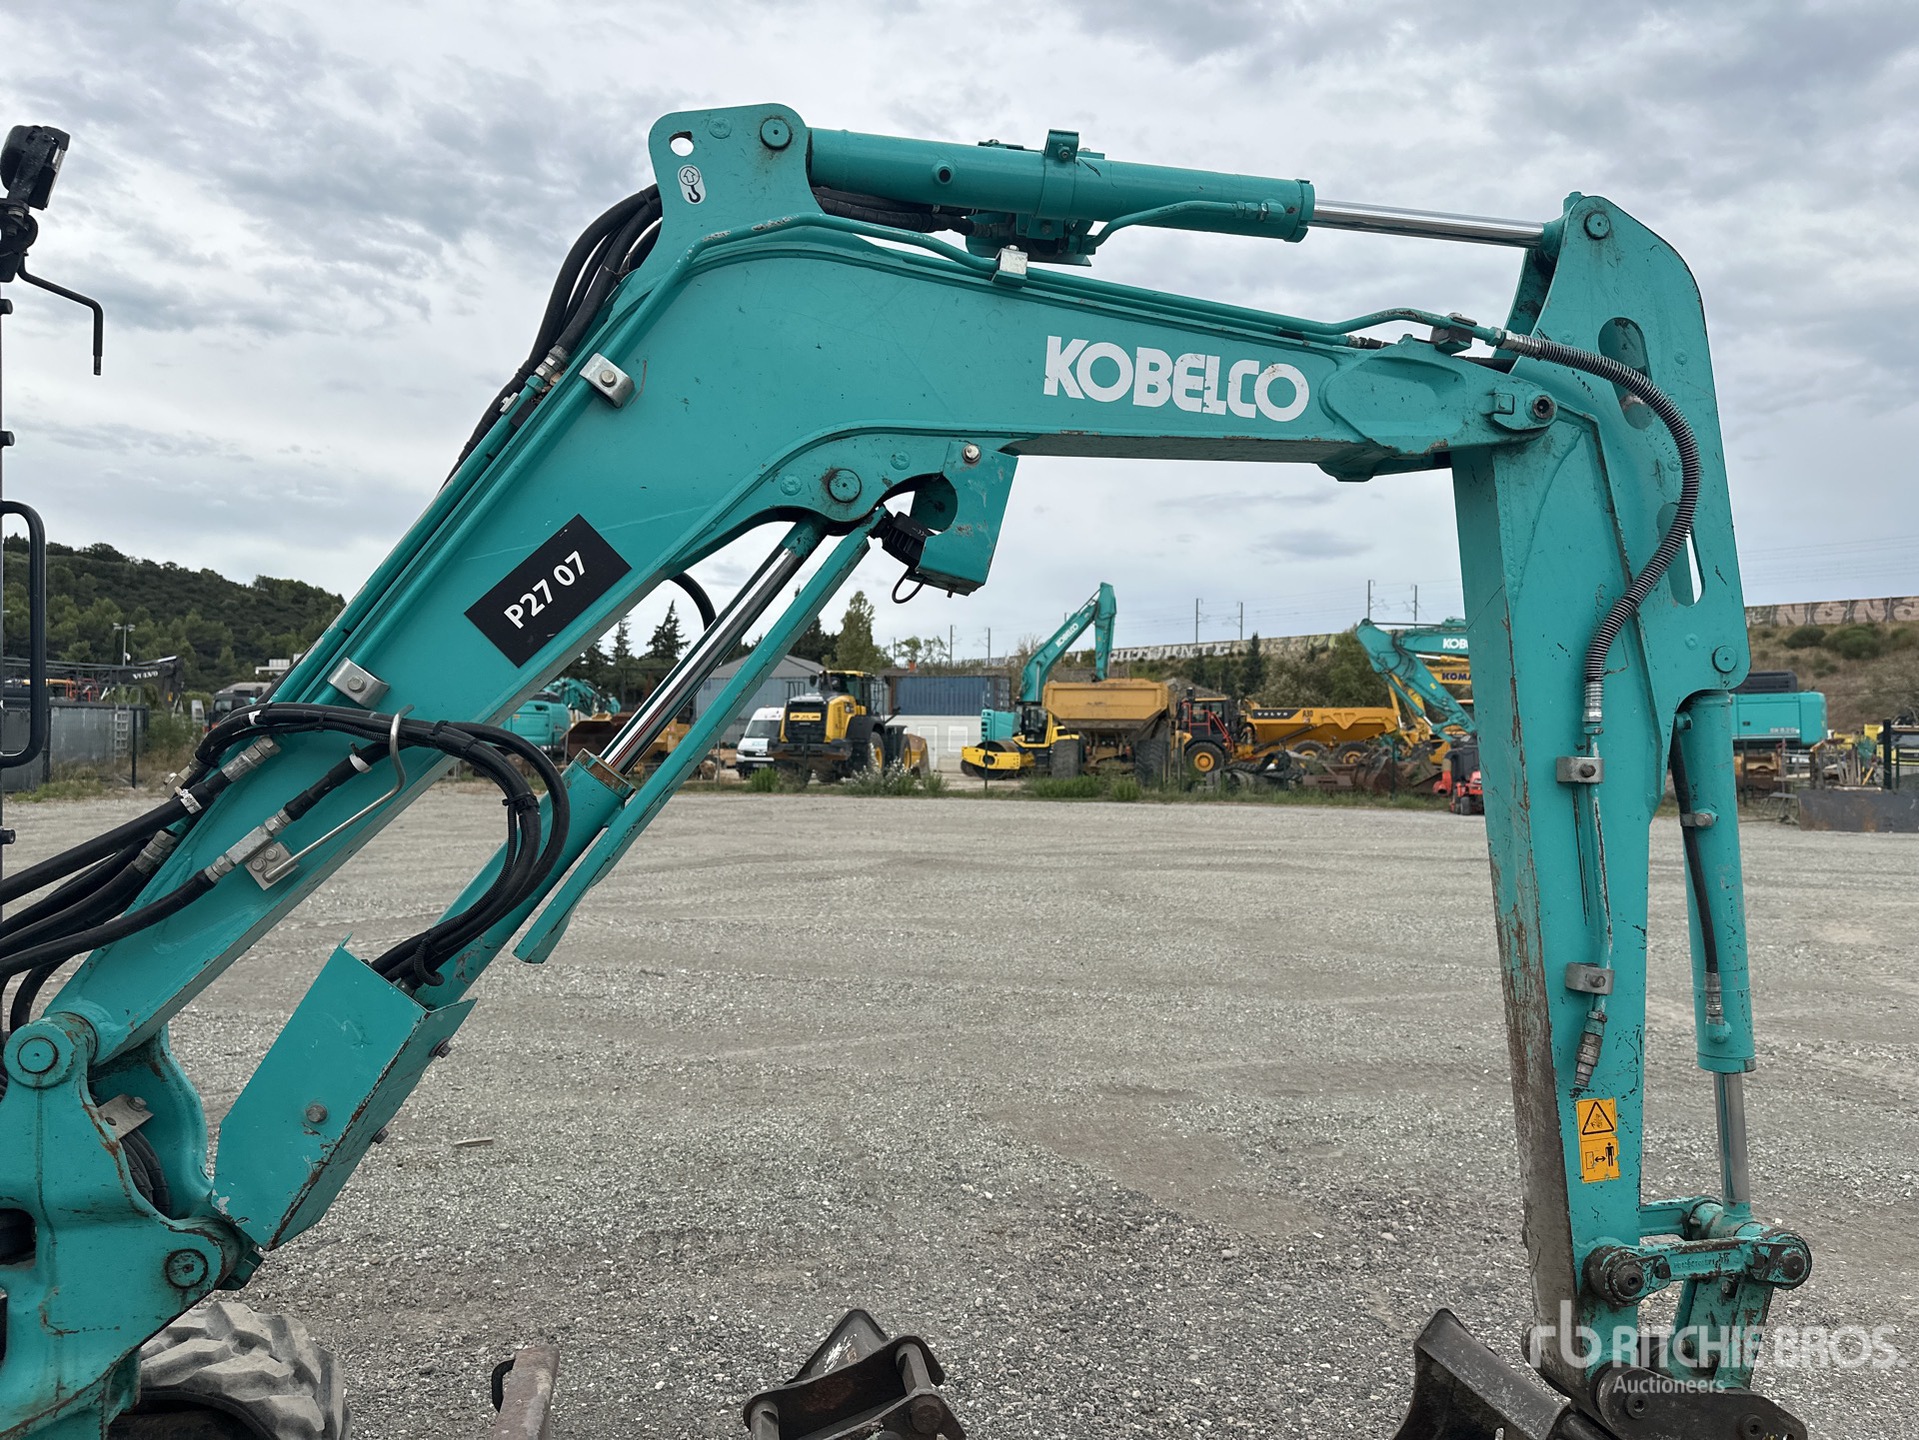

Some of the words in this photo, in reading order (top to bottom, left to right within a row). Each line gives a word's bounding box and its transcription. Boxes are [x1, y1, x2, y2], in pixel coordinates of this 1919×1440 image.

[1043, 335, 1310, 422] KOBELCO
[503, 578, 553, 630] P27
[553, 550, 586, 587] 07
[1442, 638, 1468, 649] KOB
